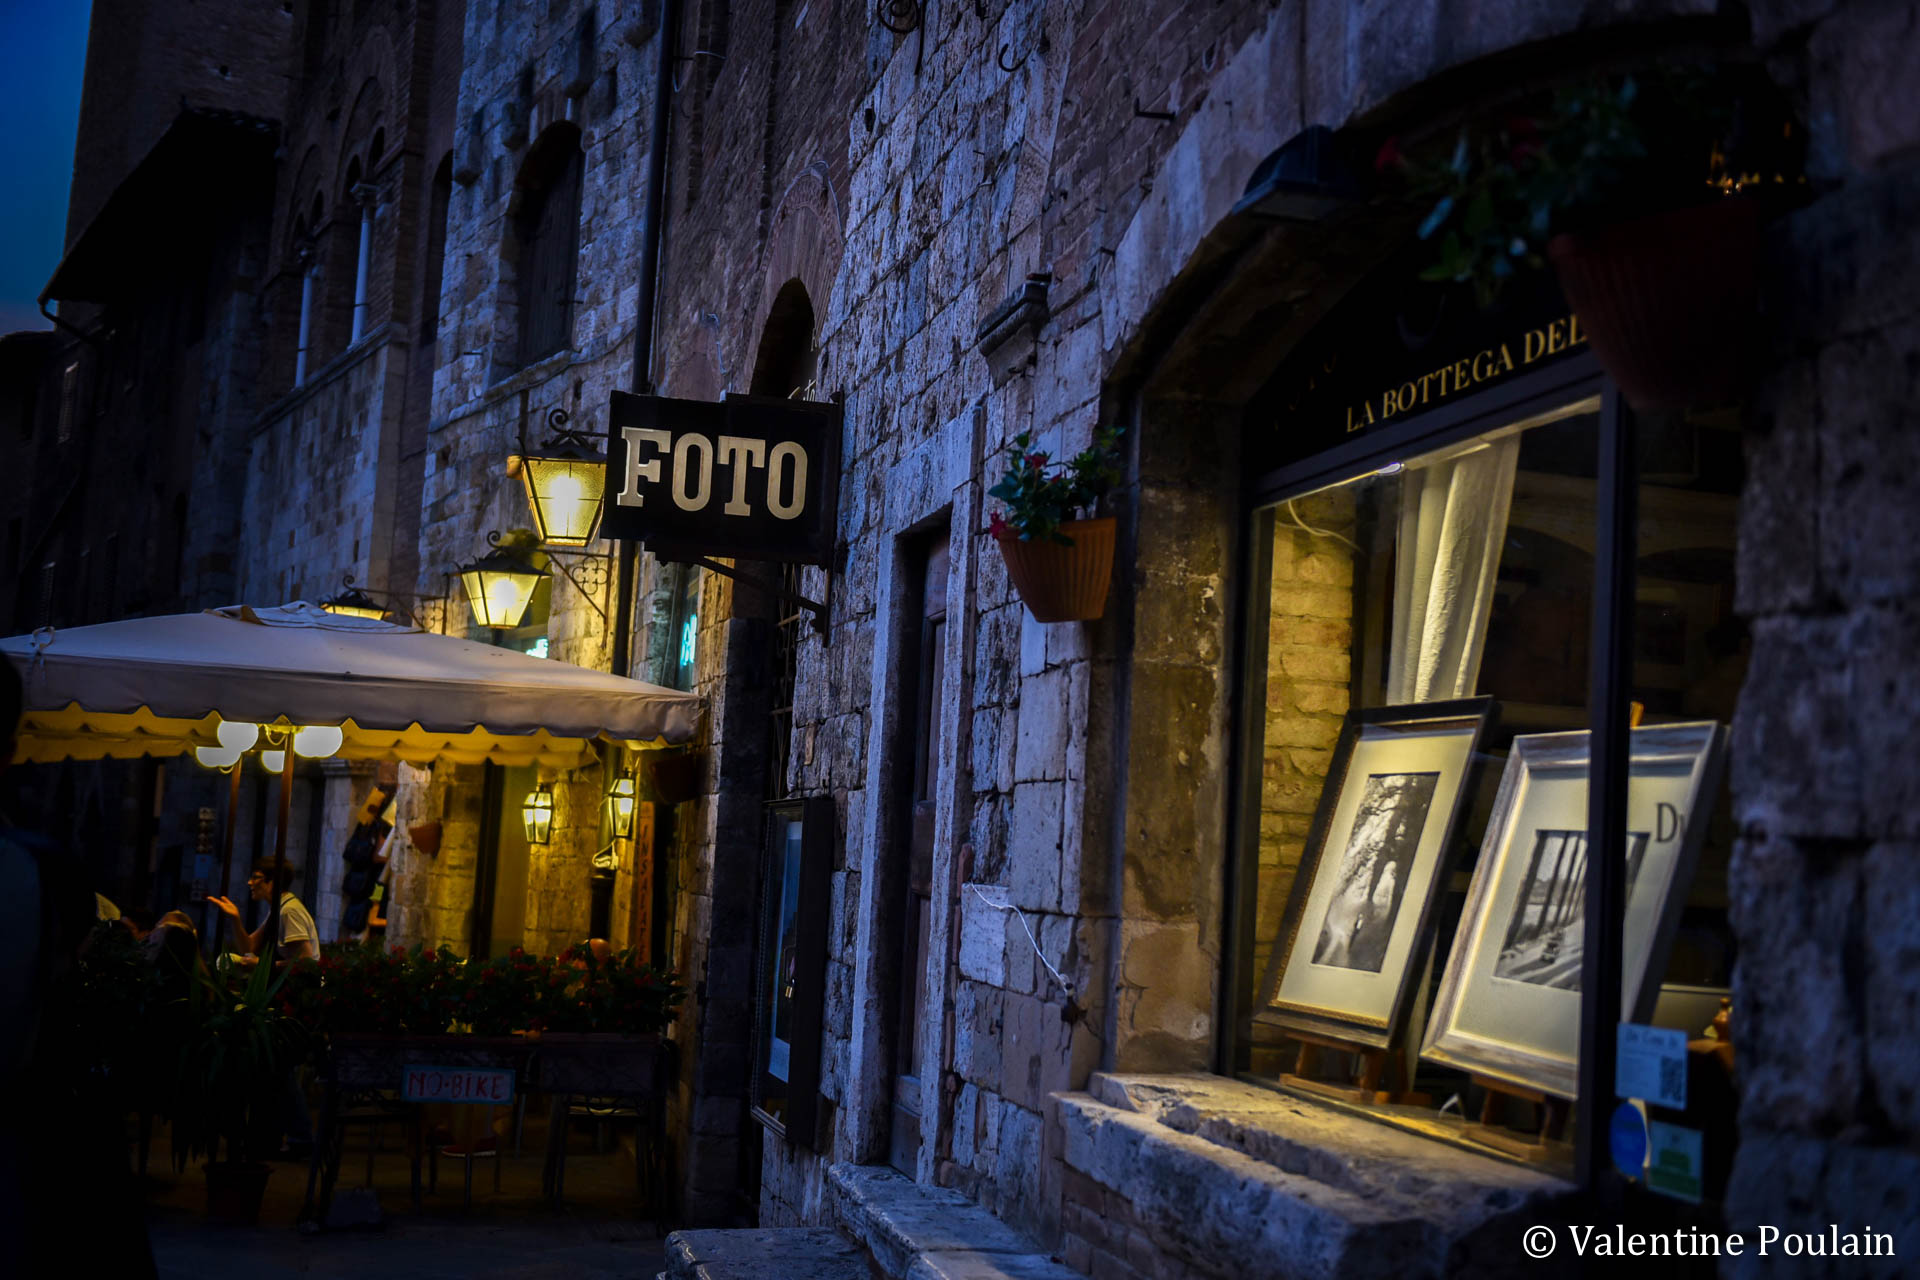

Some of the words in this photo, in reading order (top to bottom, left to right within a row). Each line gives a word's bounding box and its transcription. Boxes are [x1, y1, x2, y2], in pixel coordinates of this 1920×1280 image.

[1345, 400, 1375, 433] LA
[1382, 343, 1515, 420] BOTTEGA
[616, 425, 809, 520] FOTO
